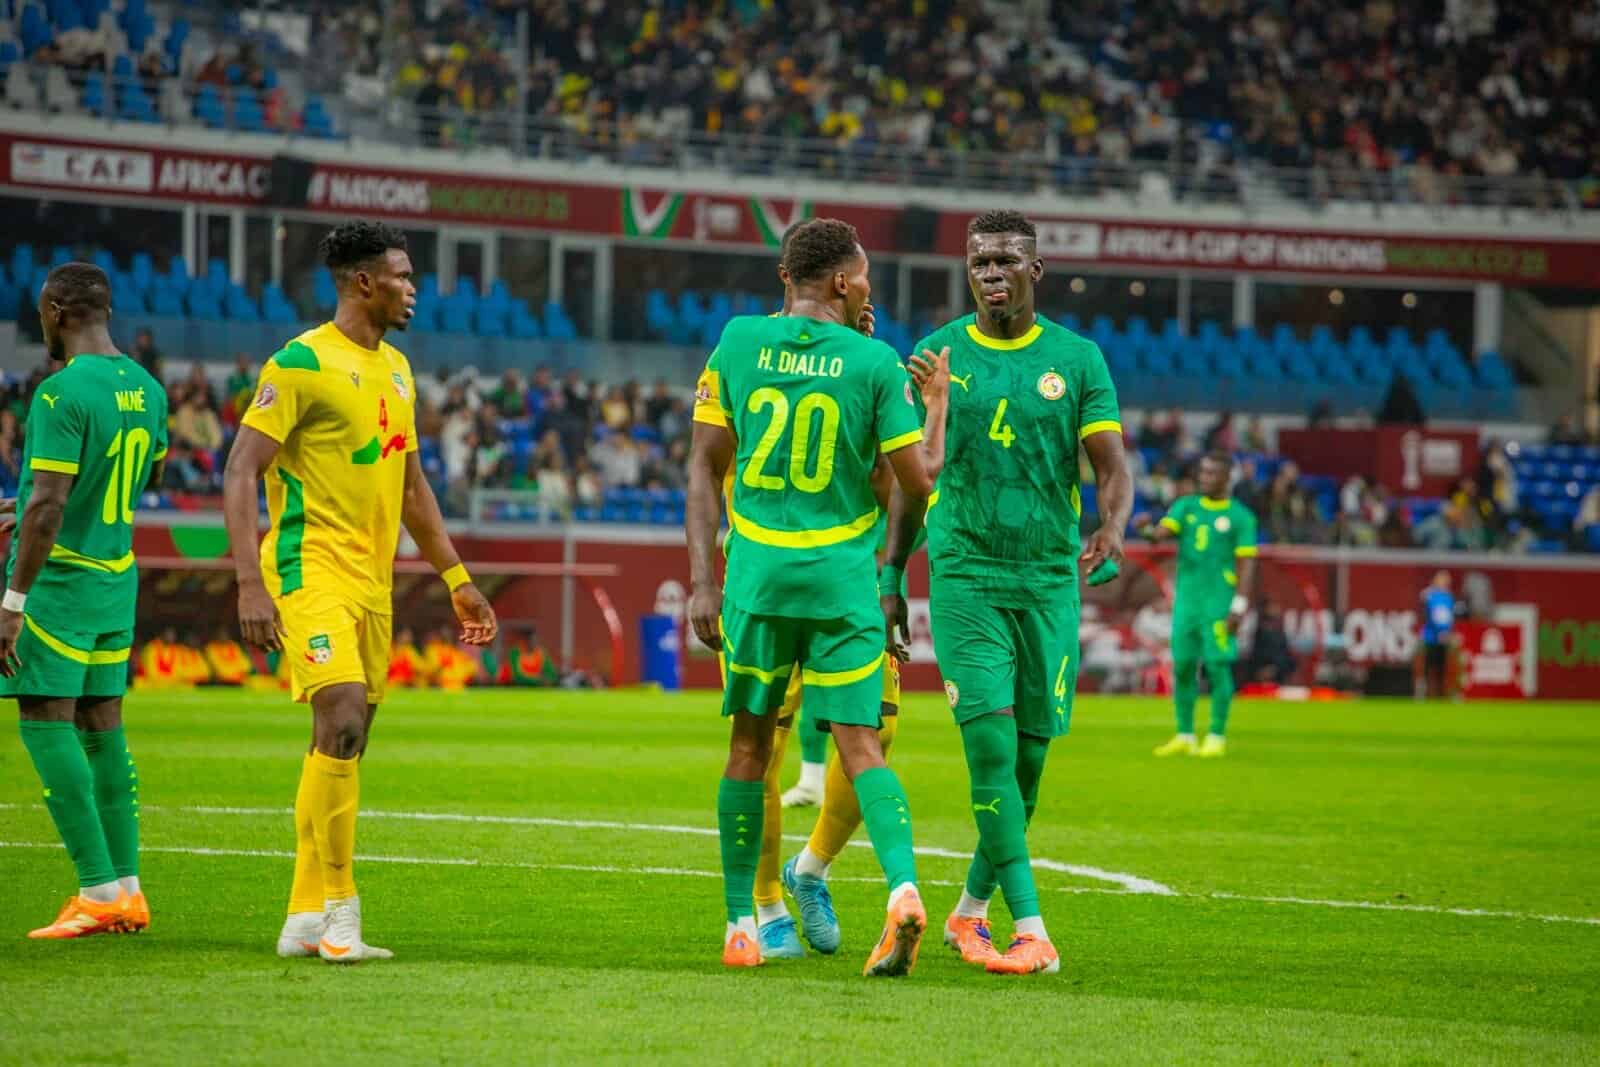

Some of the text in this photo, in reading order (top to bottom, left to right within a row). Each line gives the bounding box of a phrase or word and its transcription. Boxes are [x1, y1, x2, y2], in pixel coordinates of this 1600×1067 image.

[66, 152, 136, 183] CAF
[159, 158, 246, 197] AFRICA
[330, 172, 431, 213] NATIONS
[1105, 226, 1188, 261] AFRICA
[1193, 232, 1240, 264] CUP
[1241, 233, 1276, 266] OF
[1278, 237, 1386, 272] NATIONS
[757, 347, 843, 378] H. DIALLO
[378, 397, 388, 432] 4
[988, 398, 1016, 448] 4
[742, 387, 840, 493] 20
[102, 427, 150, 525] 10
[1054, 655, 1069, 702] 4
